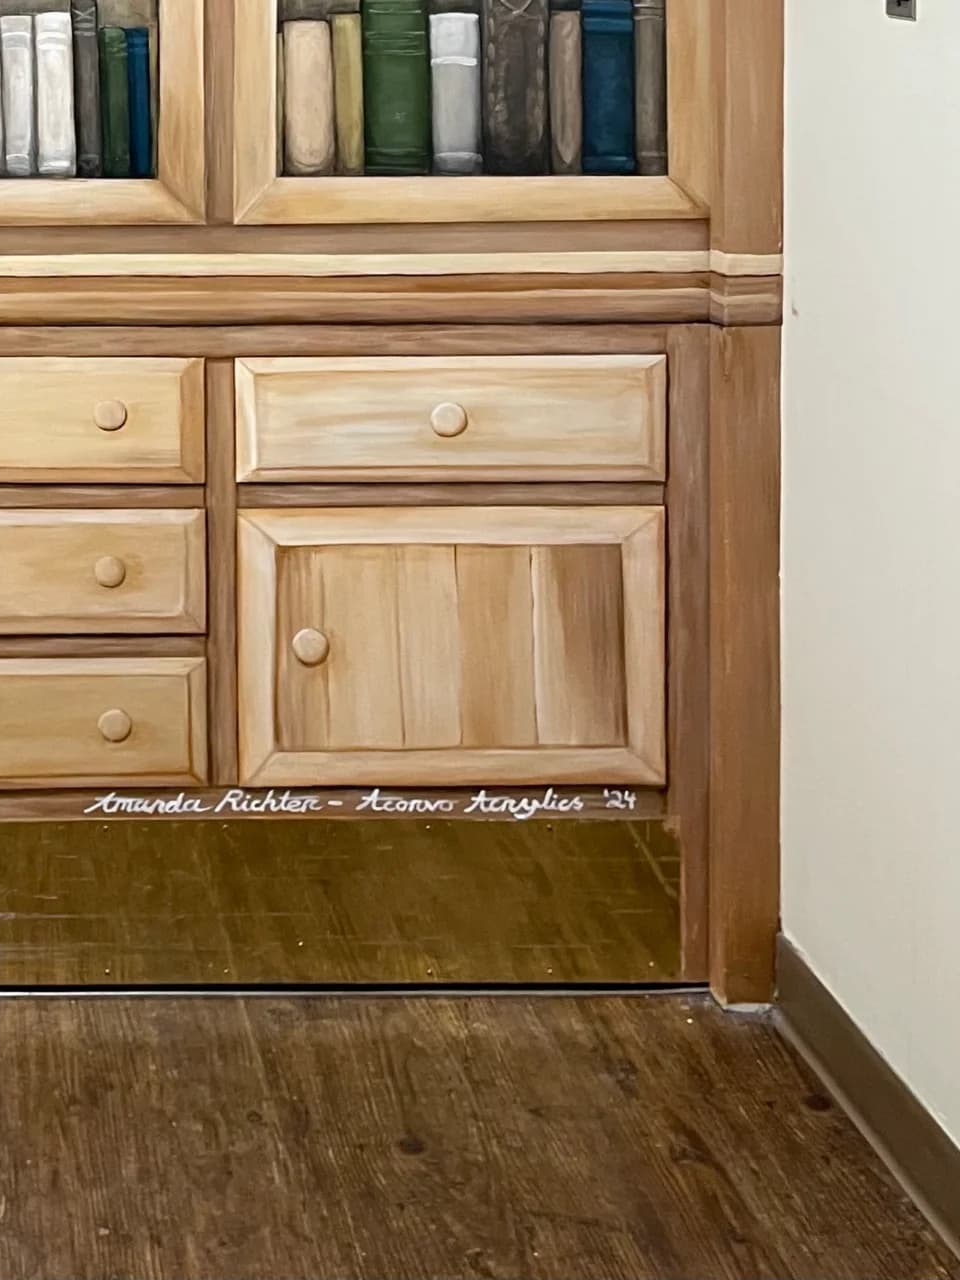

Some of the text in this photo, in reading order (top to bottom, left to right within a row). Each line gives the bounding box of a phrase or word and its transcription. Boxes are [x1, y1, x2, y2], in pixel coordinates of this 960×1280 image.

[84, 792, 213, 814] Amanda
[214, 789, 323, 814] Richter
[463, 787, 585, 820] Acrylics
